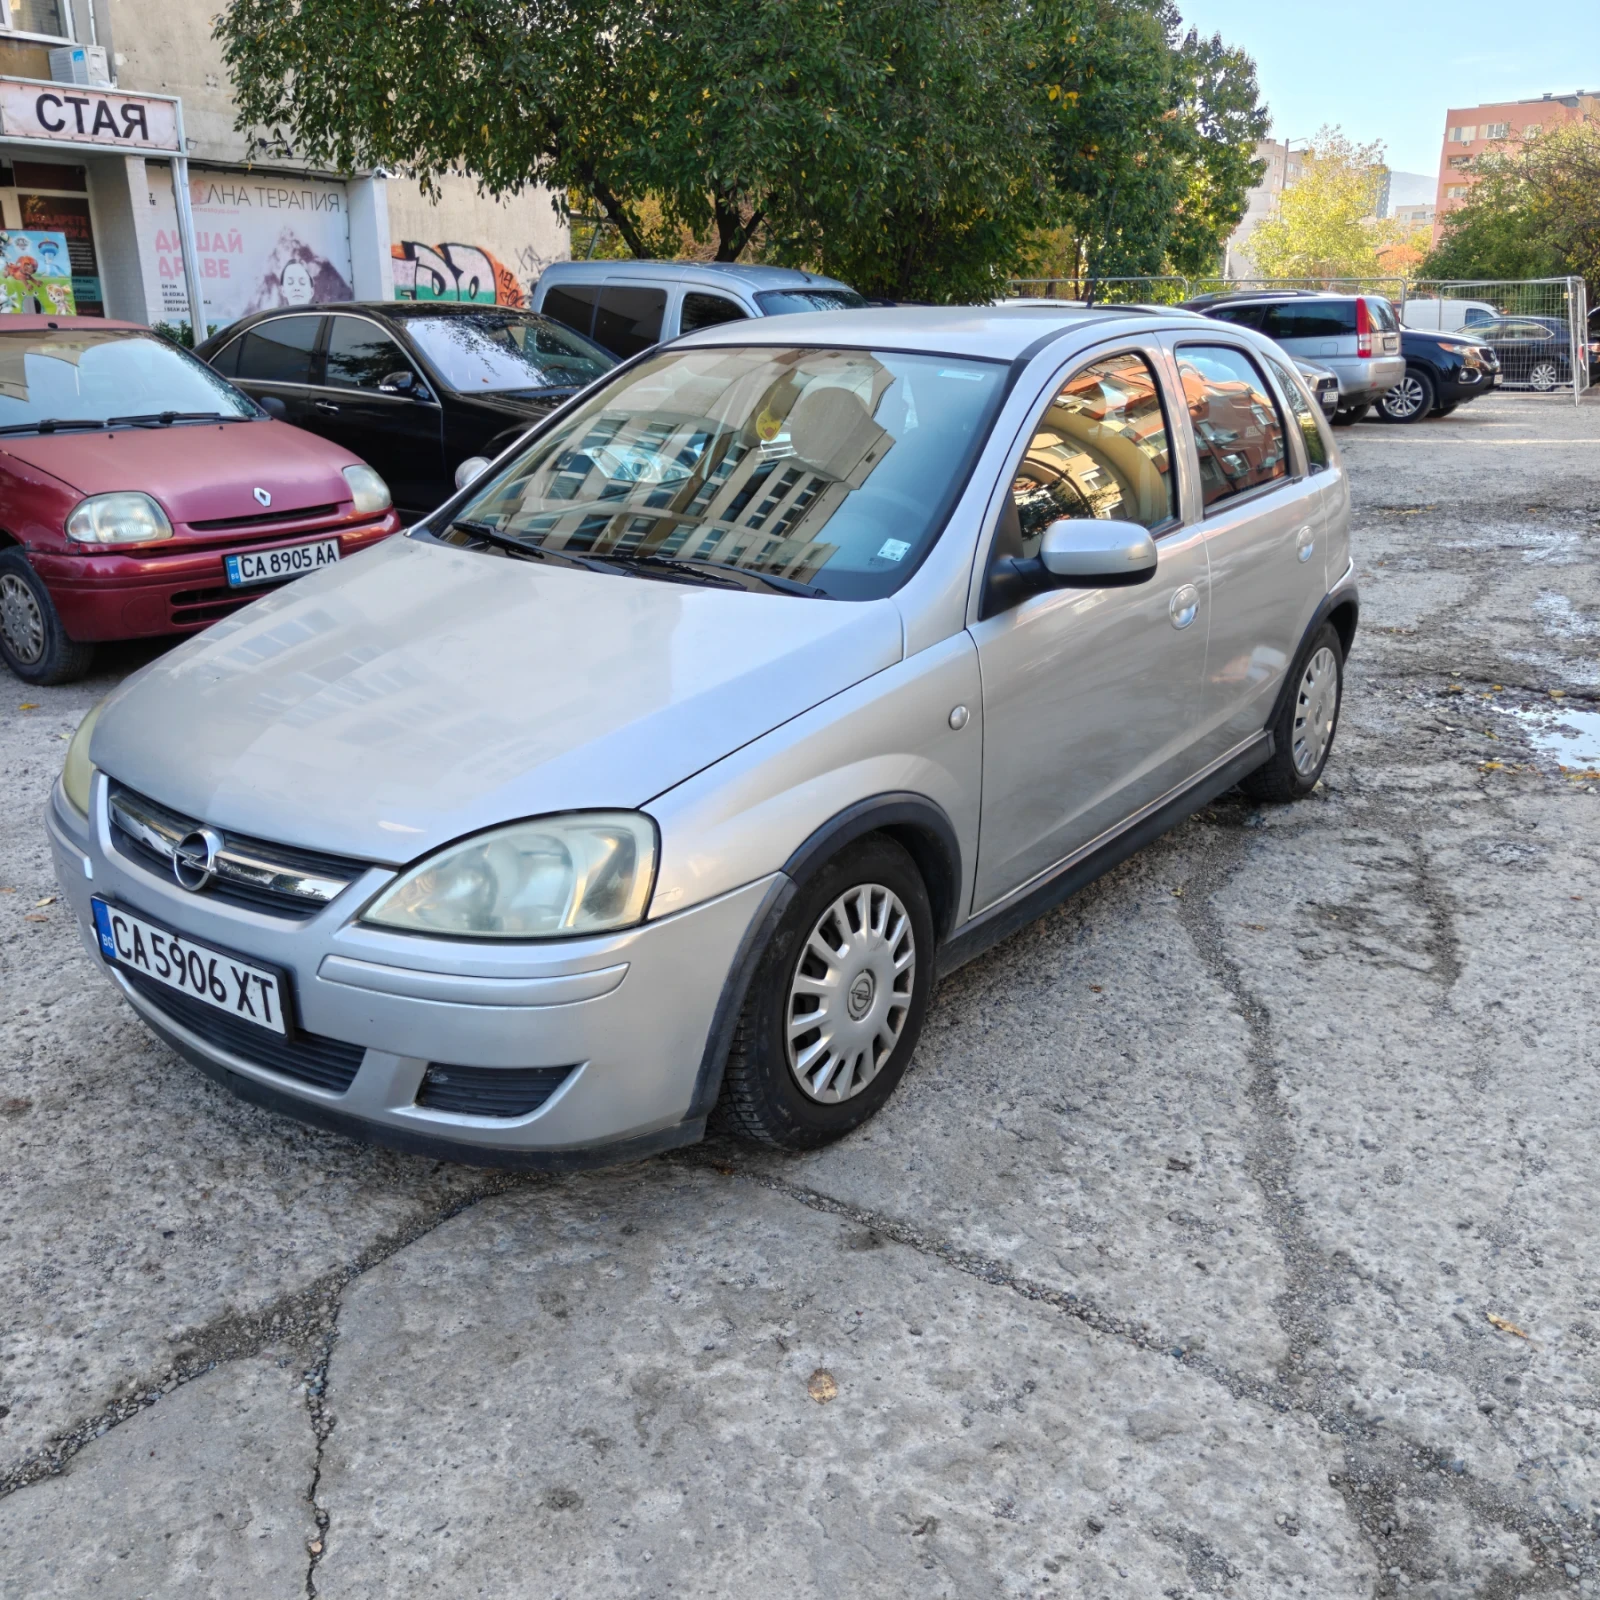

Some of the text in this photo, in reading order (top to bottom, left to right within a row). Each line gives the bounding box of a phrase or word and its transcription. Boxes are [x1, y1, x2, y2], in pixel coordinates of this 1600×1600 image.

[36, 93, 149, 140] СТАЯ
[254, 186, 340, 212] ТЕРАПИЯ
[241, 543, 337, 578] CA 8905 AA
[102, 933, 114, 950] BG
[112, 915, 274, 1023] CA 5906 XT
